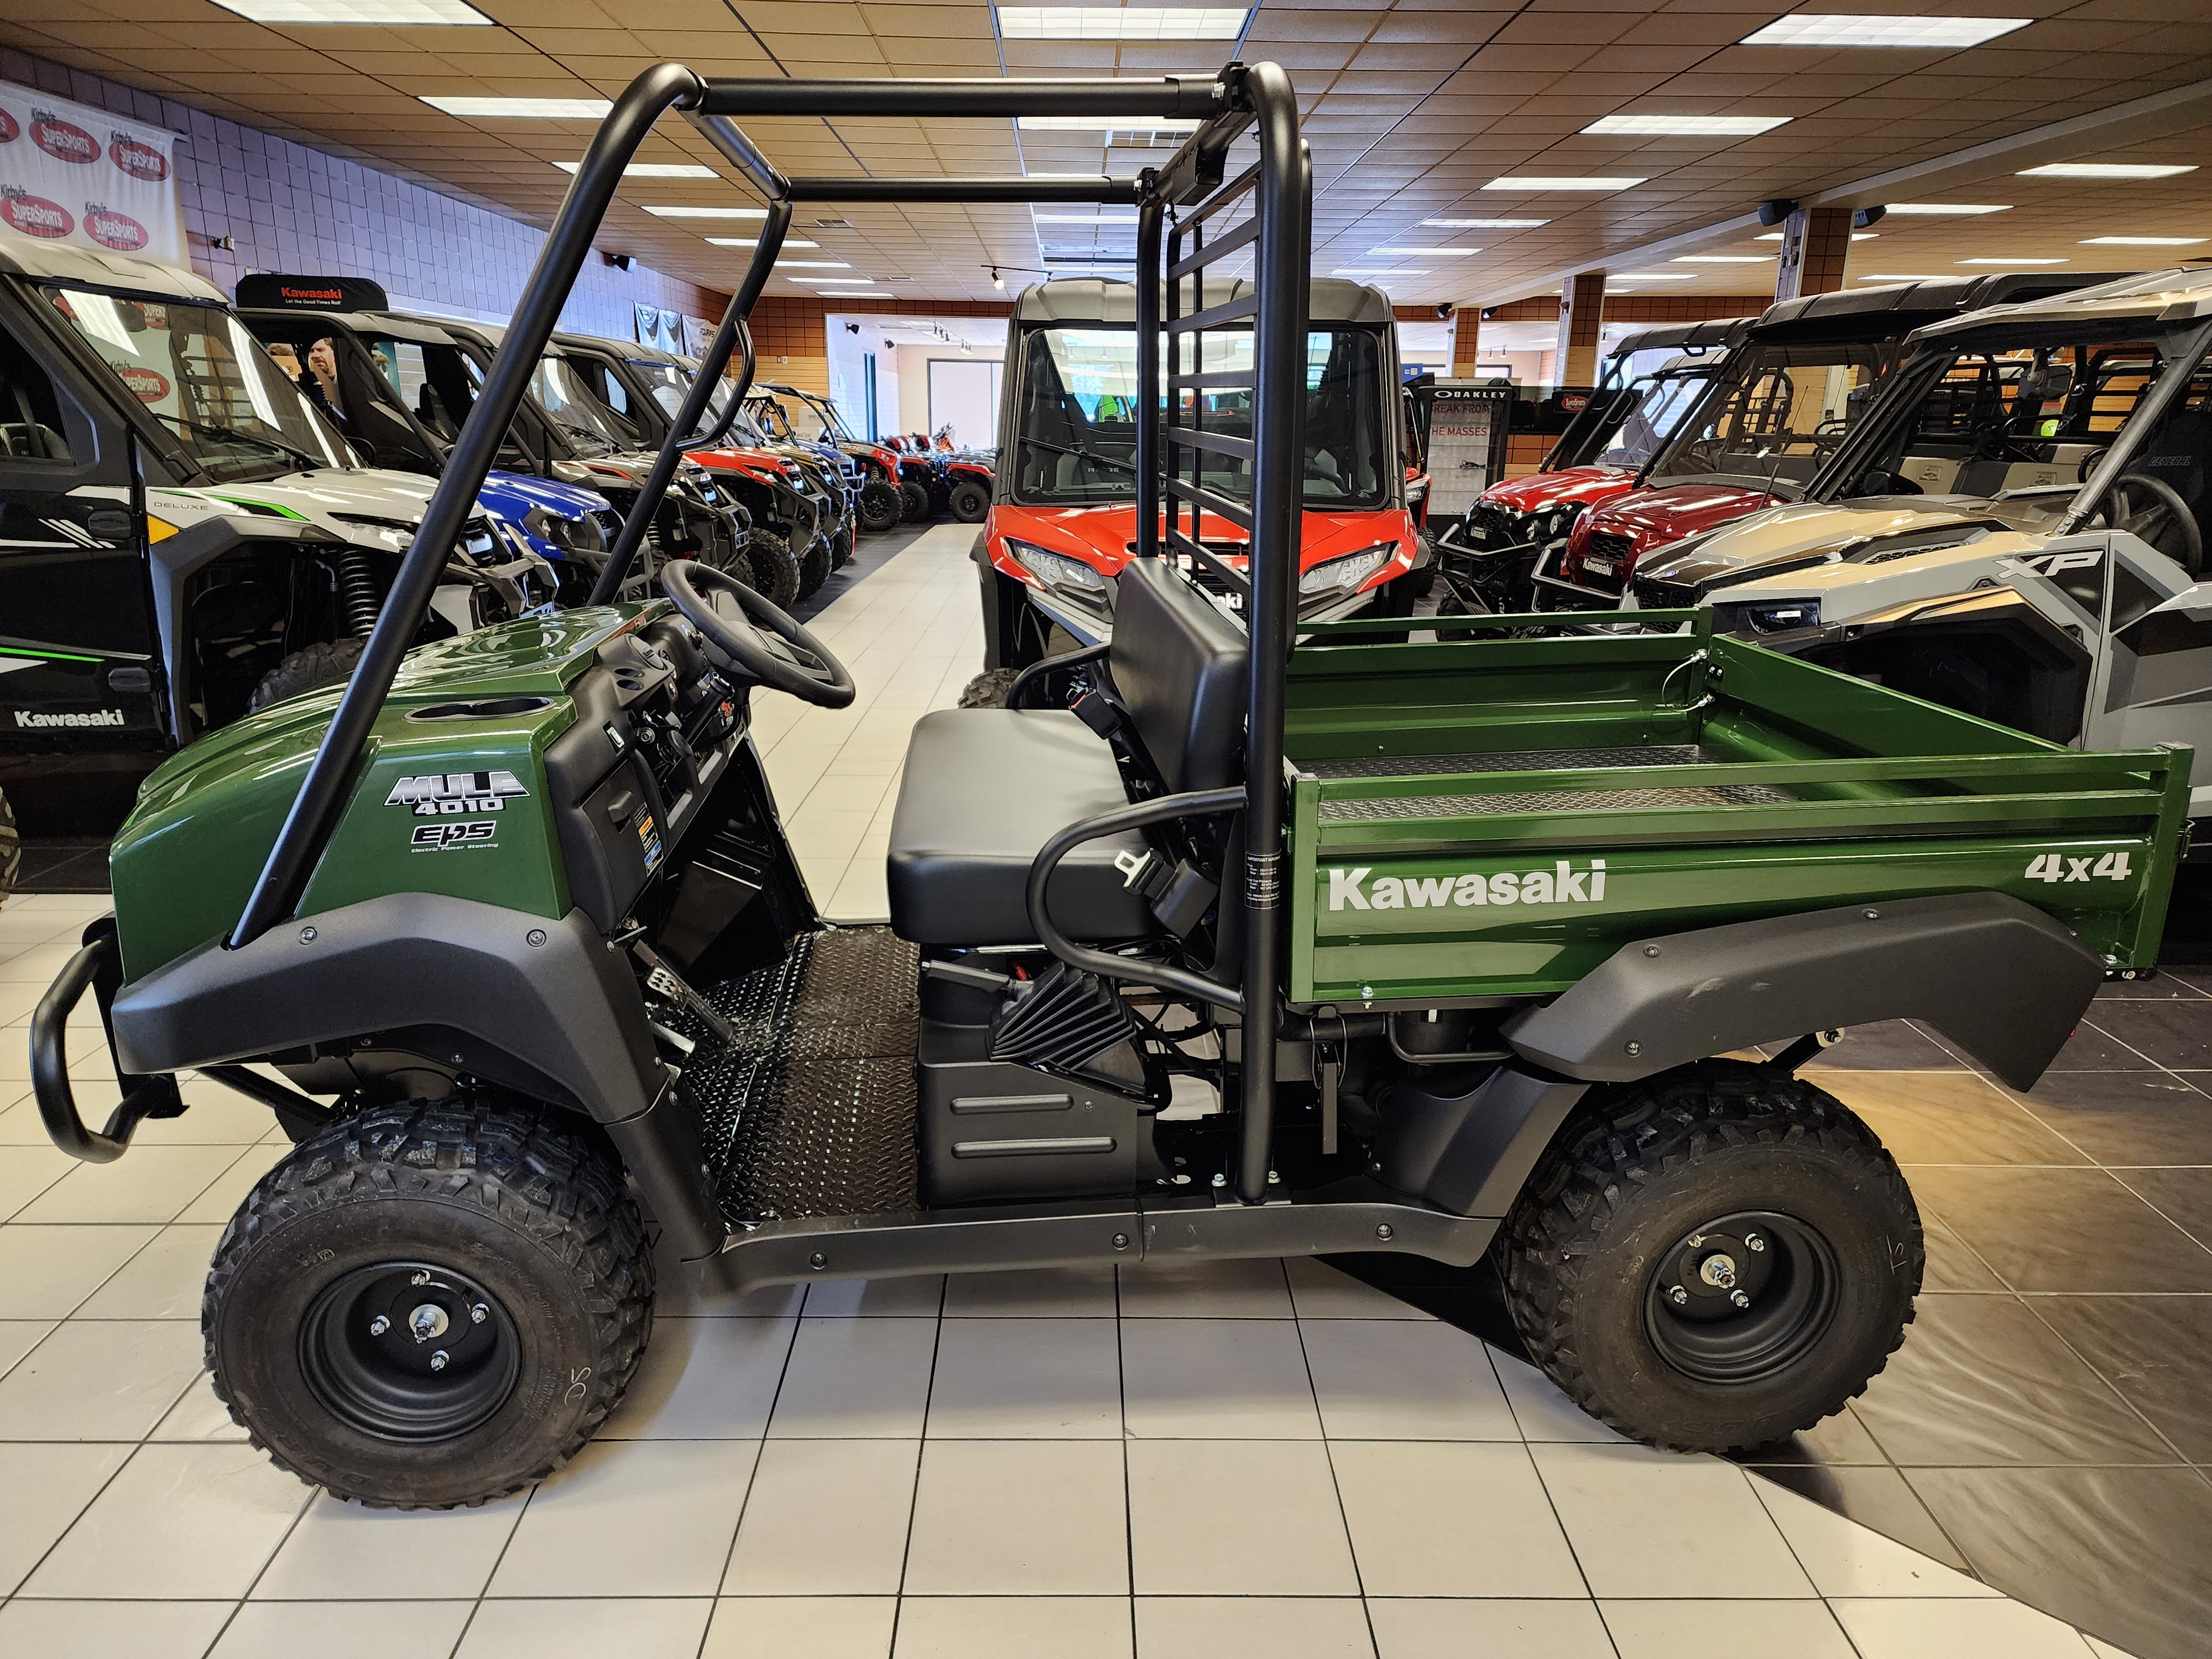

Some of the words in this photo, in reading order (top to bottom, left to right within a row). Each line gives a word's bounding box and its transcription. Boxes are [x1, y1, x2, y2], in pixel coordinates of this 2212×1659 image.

[281, 287, 342, 299] Kawasaki
[1433, 404, 1460, 413] REAK
[1463, 404, 1490, 413] FROM
[1431, 426, 1445, 436] HE
[1447, 427, 1487, 436] MASSES
[2149, 456, 2191, 466] GENERAL
[154, 502, 208, 510] DELUXE
[1583, 558, 1613, 576] Kawasaki
[1994, 551, 2104, 579] XP
[14, 709, 124, 728] Kawasaki
[384, 770, 531, 806] MULE
[415, 799, 504, 815] 4010
[411, 820, 497, 847] EPS
[2025, 852, 2132, 882] 4x4
[1328, 859, 1606, 911] Kawasaki
